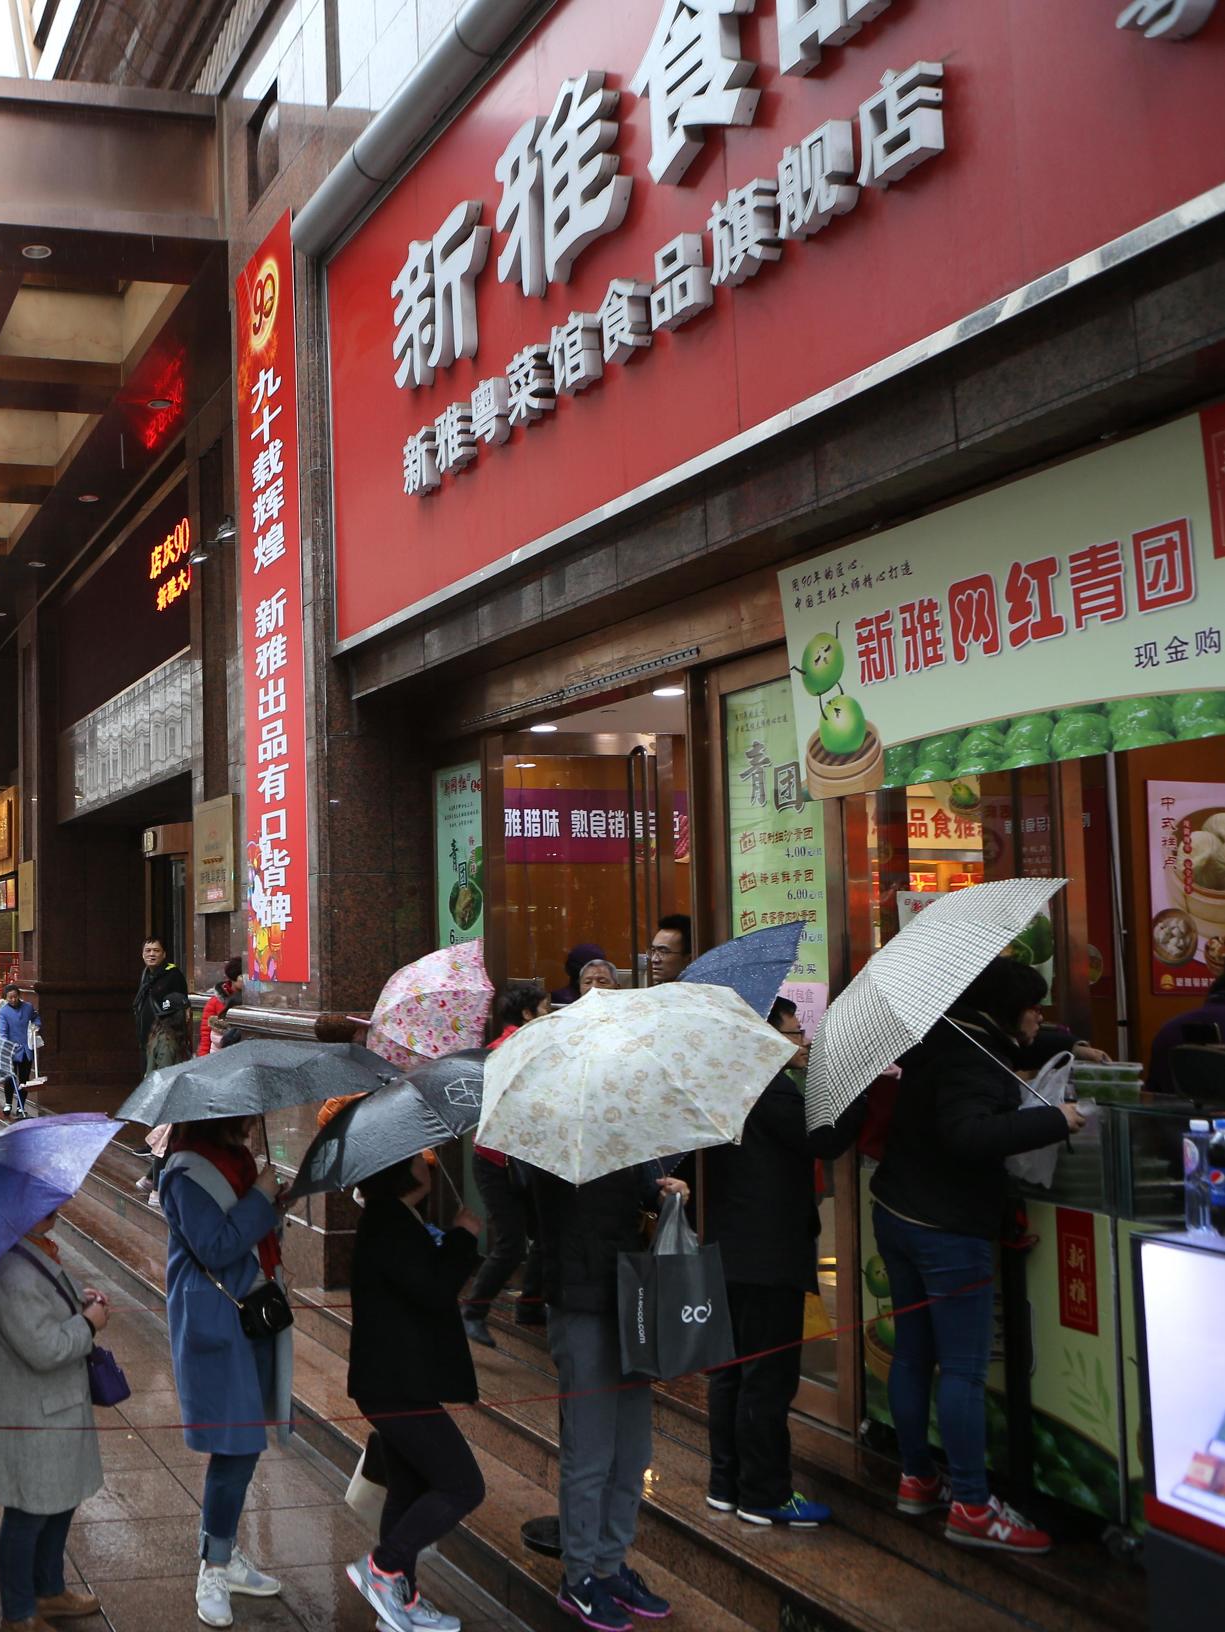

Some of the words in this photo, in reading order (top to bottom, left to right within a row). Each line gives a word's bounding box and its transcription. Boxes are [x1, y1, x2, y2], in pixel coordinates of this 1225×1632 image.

[253, 272, 276, 336] 90
[403, 61, 944, 496] 新雅粤菜馆食品旗舰店
[250, 366, 286, 575] 九十载辉煌
[854, 517, 1195, 686] 新雅网红青团
[254, 587, 293, 932] 新雅出品有口皆碑
[739, 740, 805, 815] 青团
